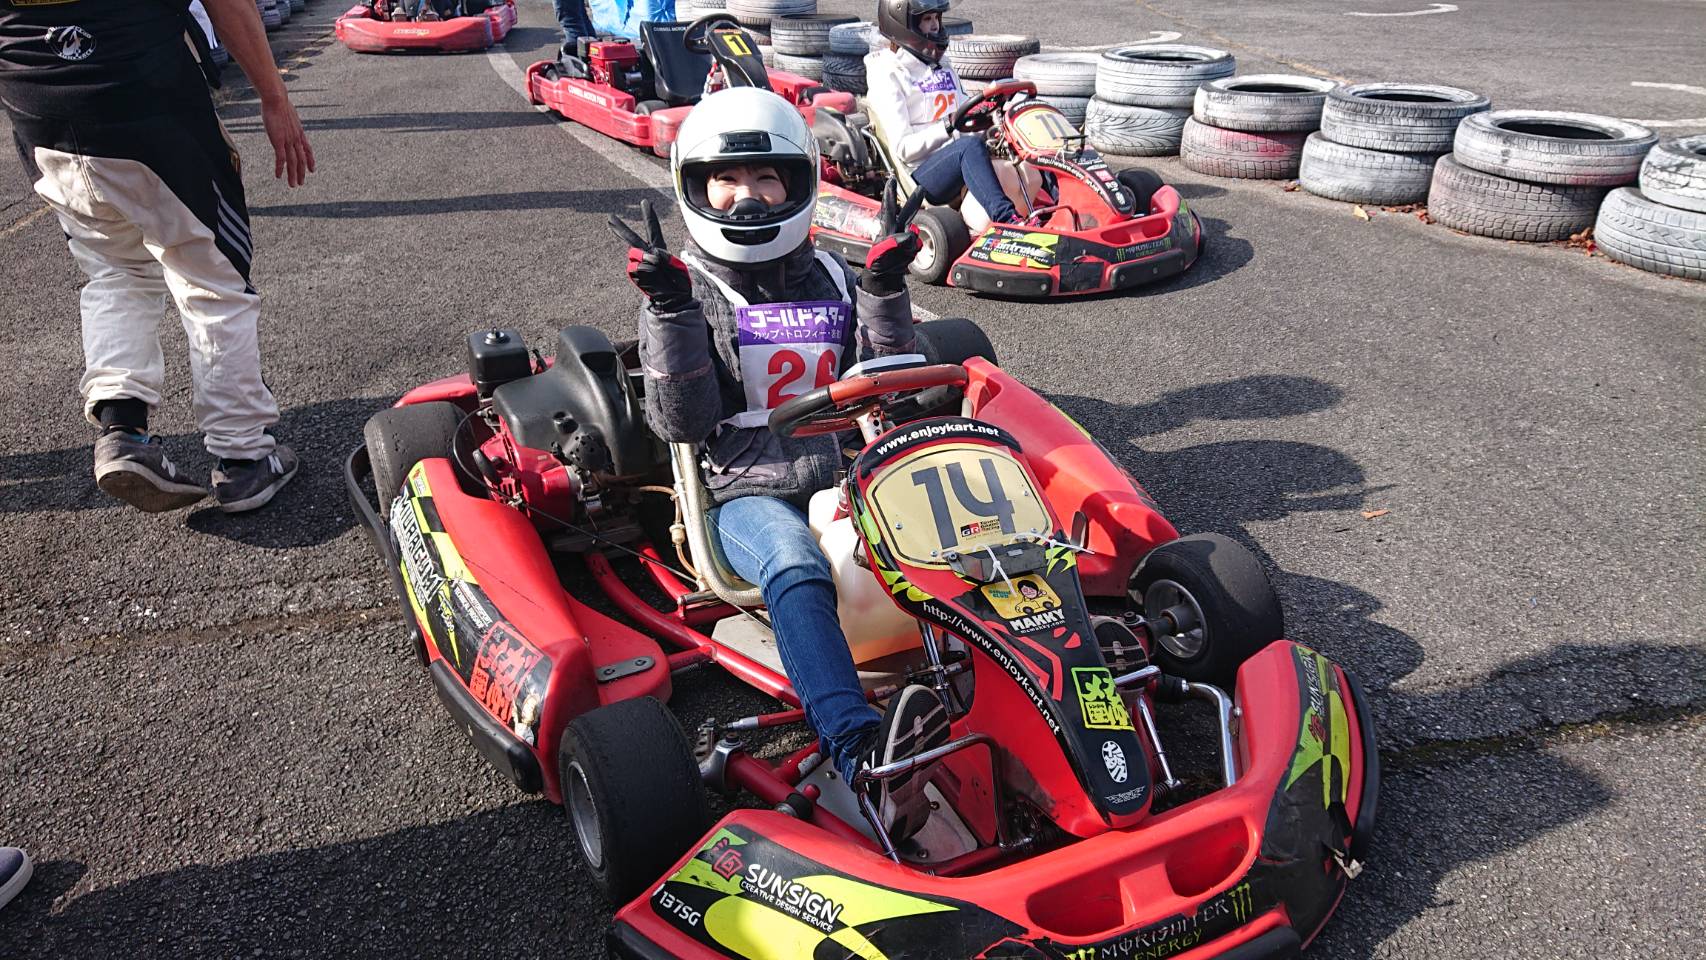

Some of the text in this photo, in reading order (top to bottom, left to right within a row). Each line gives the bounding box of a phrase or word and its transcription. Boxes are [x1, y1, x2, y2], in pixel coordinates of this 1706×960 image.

[729, 36, 747, 53] 1
[1034, 113, 1068, 140] 11
[748, 306, 844, 328] ゴールドスター
[877, 423, 1000, 455] www.enjoykart.net
[911, 458, 1016, 549] 14
[961, 526, 980, 537] GR
[1009, 608, 1065, 631] MAKKY
[923, 602, 1061, 735] http://www.enjoykart.net
[740, 881, 834, 933] CREATIVE DESIGN SERVICE
[745, 863, 843, 924] SUNSIGN
[1135, 928, 1202, 960] ENERGY
